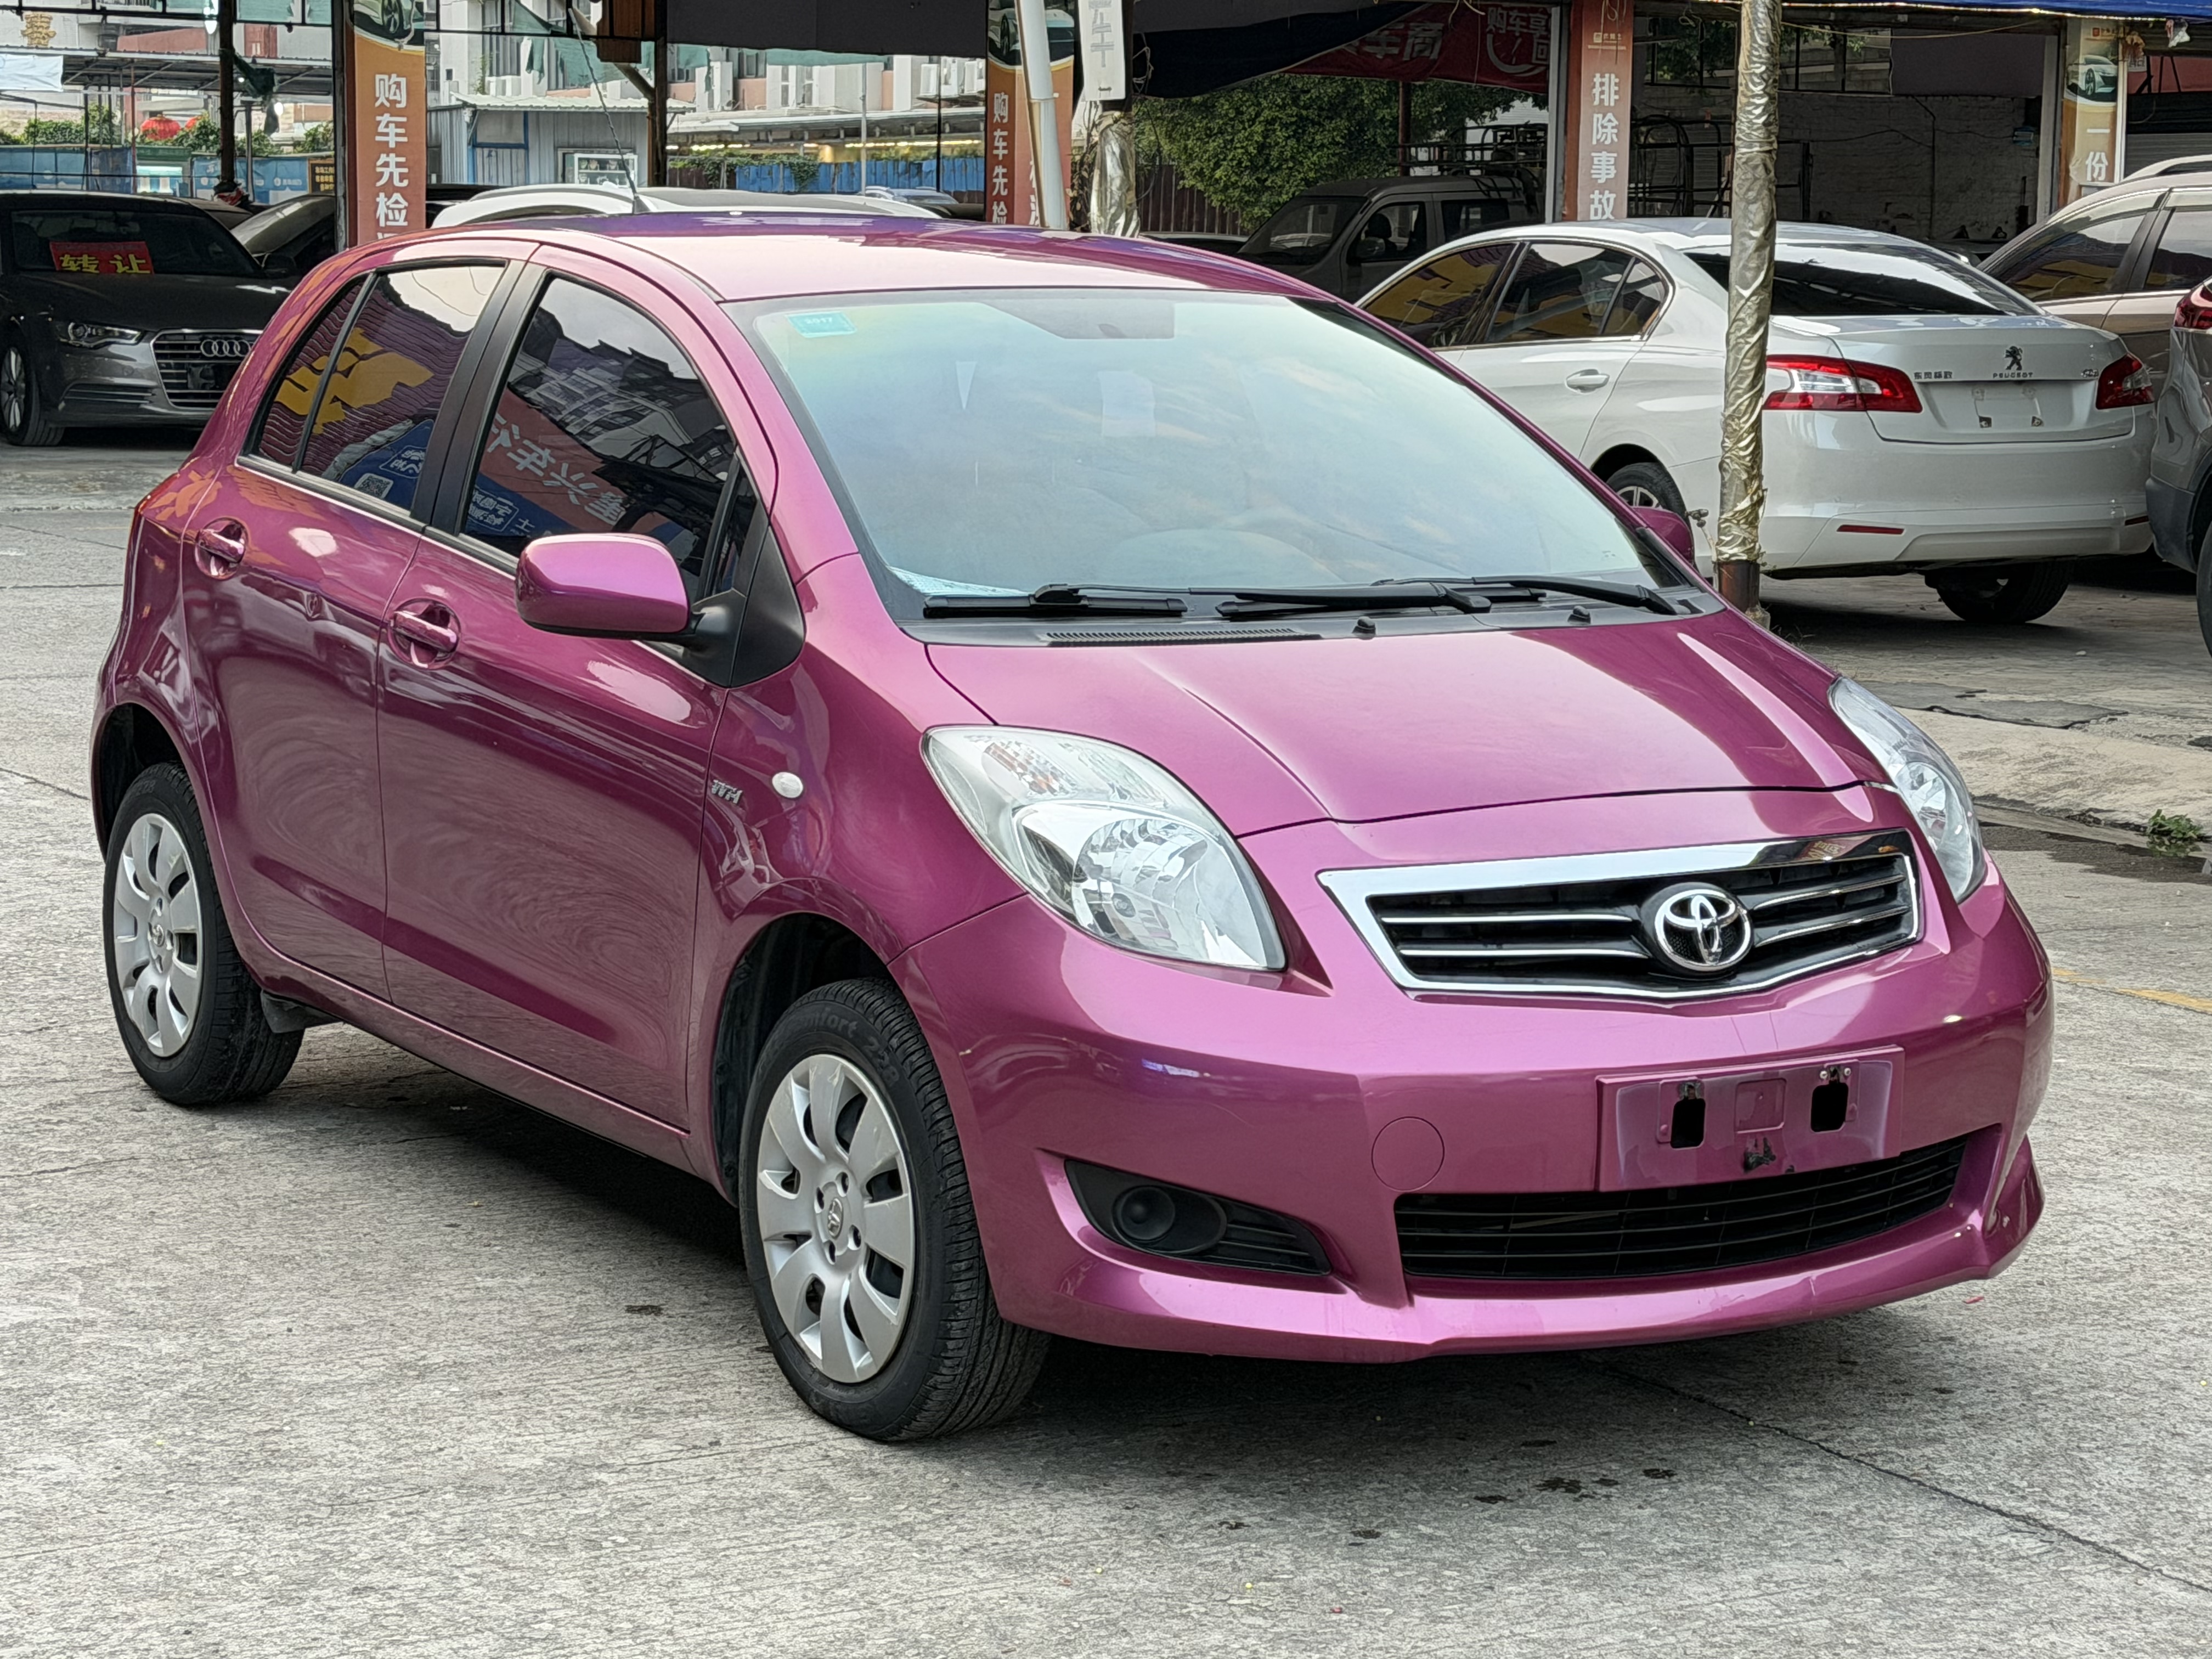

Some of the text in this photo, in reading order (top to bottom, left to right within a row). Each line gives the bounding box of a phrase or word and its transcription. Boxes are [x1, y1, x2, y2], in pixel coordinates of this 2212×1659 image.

[1344, 22, 1444, 60] 车商
[375, 74, 409, 240] 购车先检
[992, 92, 1009, 224] 购车先检
[1590, 73, 1620, 220] 排除事故
[60, 254, 150, 273] 转让
